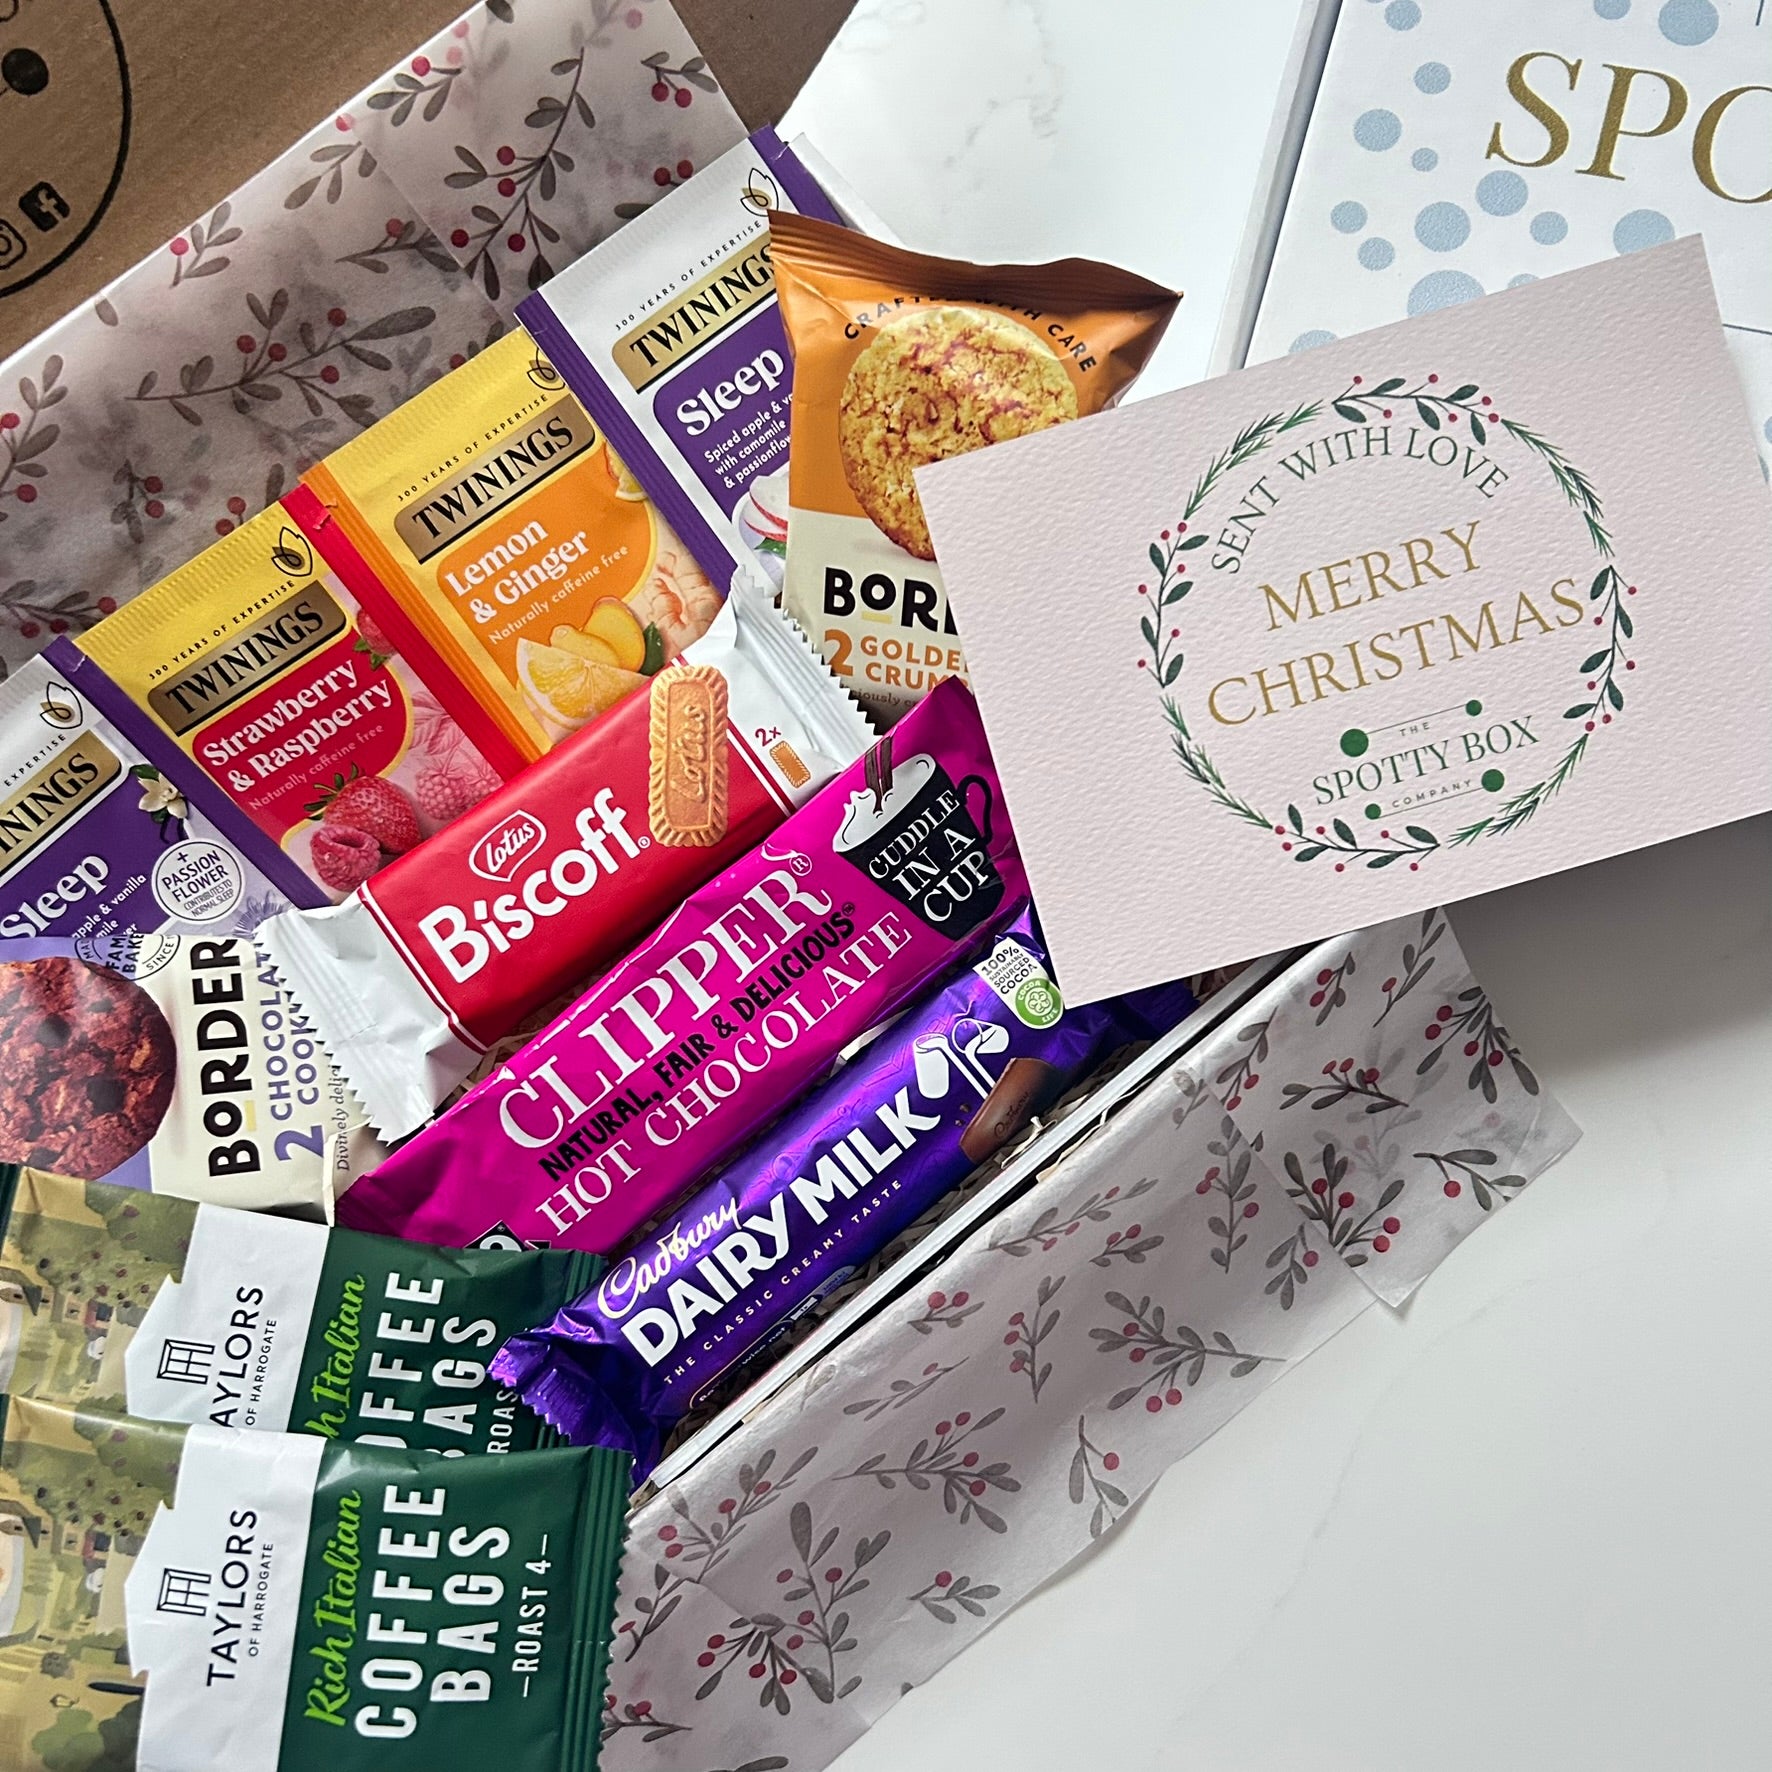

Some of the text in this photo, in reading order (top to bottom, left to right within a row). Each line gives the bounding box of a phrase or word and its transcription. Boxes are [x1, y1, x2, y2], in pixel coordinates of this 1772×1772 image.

[1485, 52, 1772, 204] SPO
[639, 283, 677, 312] YEARS
[680, 268, 696, 282] OF
[700, 220, 762, 268] EXPERTISE
[676, 349, 785, 437] Sleep
[1047, 323, 1098, 373] CARE
[422, 456, 460, 484] YEARS
[464, 441, 480, 455] OF
[485, 394, 549, 441] EXPERTISE
[704, 430, 742, 463] Spiced
[741, 411, 772, 437] apple
[770, 400, 783, 414] &
[714, 419, 786, 476] with camomile
[411, 416, 573, 539] TWININGS
[723, 476, 736, 489] &
[1210, 425, 1510, 575] SENT WITH LOVE
[444, 520, 549, 597] Lemon
[469, 531, 589, 624] & Ginger
[487, 545, 629, 645] Naturally caffeine free
[1257, 519, 1482, 632] MERRY
[165, 600, 324, 715] TWININGS
[172, 638, 209, 665] YEARS
[213, 624, 228, 637] OF
[232, 580, 296, 625] EXPERTISE
[823, 628, 854, 677] 2
[1206, 577, 1586, 726] CHRISTMAS
[202, 659, 358, 766] Strawberry
[227, 679, 392, 793] & Raspberry
[1399, 721, 1431, 737] THE
[4, 733, 66, 788] EXPERTISE
[247, 723, 385, 811] Naturally caffeine free
[1312, 715, 1541, 805] SPOTTY BOX
[1392, 778, 1473, 808] COMPANY
[161, 850, 221, 890] PASSION
[484, 820, 536, 874] Lotus
[868, 789, 961, 880] CUDDLE
[892, 828, 976, 901] IN A
[0, 855, 109, 938] Sleep
[98, 903, 113, 915] &
[111, 873, 147, 905] vanilla
[171, 864, 229, 903] FLOWER
[184, 879, 232, 910] CONTRIBUTES TO
[191, 889, 233, 916] NORMAL SLEEP
[417, 786, 641, 984] Biscoff
[923, 850, 989, 922] CUP
[145, 942, 175, 971] SINCE
[981, 946, 1020, 977] 100%
[989, 953, 1024, 982] SUSTAINABLY
[993, 957, 1030, 988] SOURCED
[999, 963, 1038, 995] COCOA
[1017, 980, 1041, 1001] COCOA
[253, 944, 326, 1162] 2 CHOCOLAT
[498, 867, 833, 1149] CLIPPER
[537, 909, 856, 1182] NATURAL, FAIR & DELICIOUS
[1041, 1007, 1060, 1023] LIFE
[189, 938, 262, 1178] BORDER
[535, 910, 913, 1237] HOT CHOCOLATE
[331, 1107, 350, 1172] Divinely
[597, 1197, 743, 1320] Cadbury
[620, 1191, 790, 1368] DAIRY
[789, 1085, 941, 1225] MILK
[664, 1356, 696, 1386] THE
[703, 1289, 774, 1351] CLASSIC
[780, 1228, 845, 1286] CREAMY
[851, 1179, 903, 1225] TASTE
[244, 1318, 278, 1427] OF HARROGATE
[311, 1273, 366, 1408] Italian
[424, 1316, 497, 1458] AGS
[487, 1381, 519, 1454] ROAS
[206, 1508, 259, 1688] TAYLORS
[247, 1542, 275, 1657] OF HARROGATE
[313, 1489, 364, 1634] Italian
[354, 1484, 447, 1740] COFFEE
[429, 1525, 511, 1702] BAGS
[304, 1632, 356, 1727] Rich
